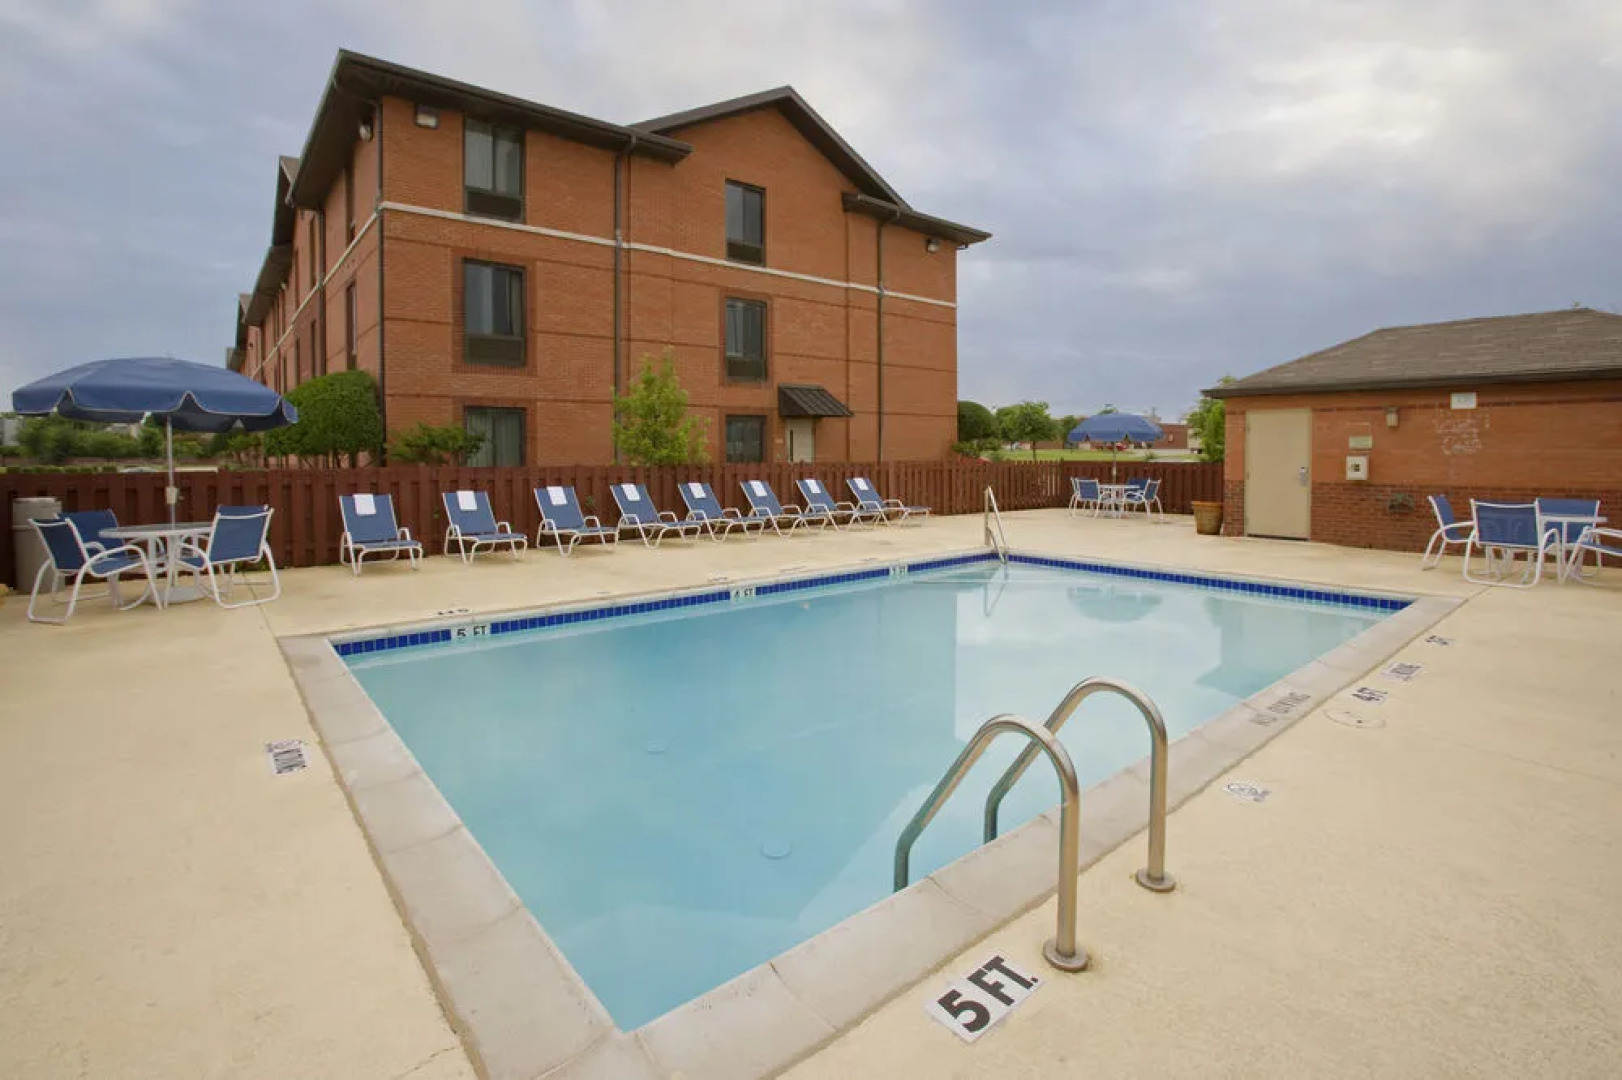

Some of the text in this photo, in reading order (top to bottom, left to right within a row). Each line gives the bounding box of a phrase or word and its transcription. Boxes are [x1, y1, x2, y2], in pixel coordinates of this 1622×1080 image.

[473, 625, 486, 636] FT
[937, 955, 1039, 1033] 5 FT.
